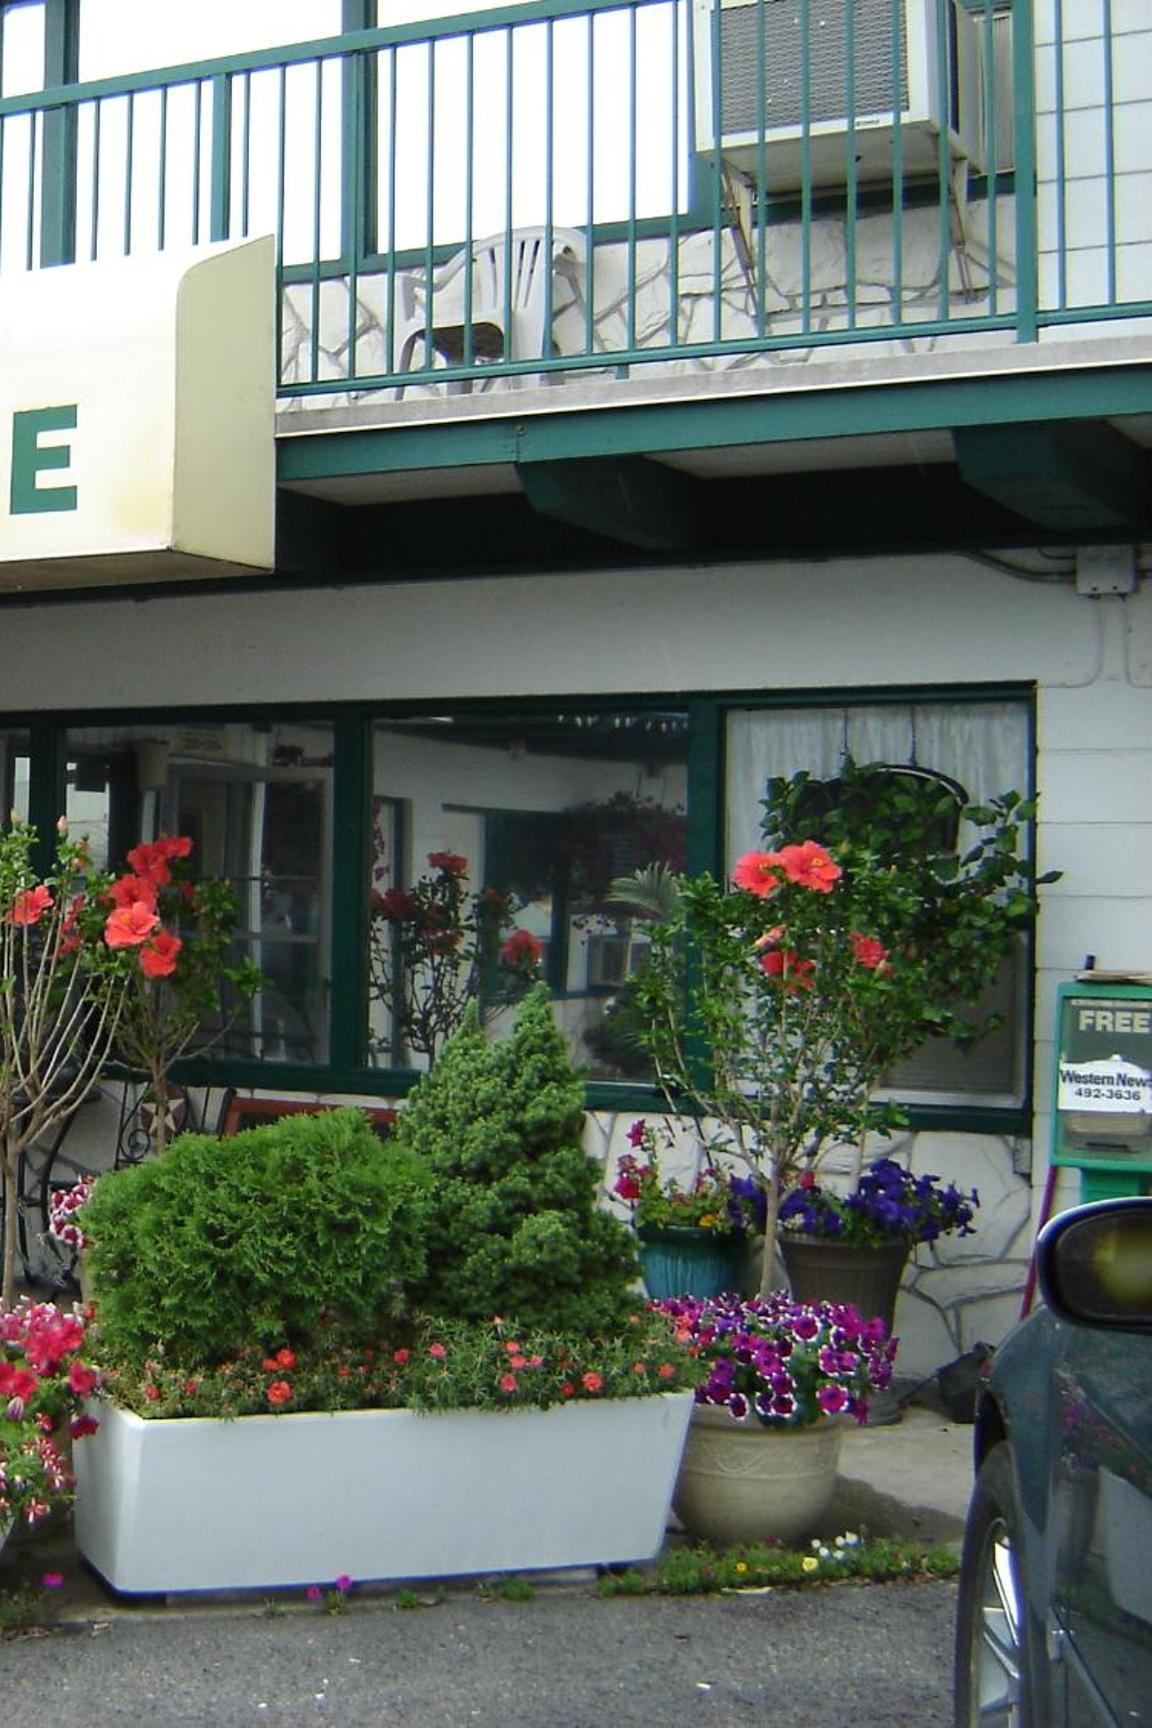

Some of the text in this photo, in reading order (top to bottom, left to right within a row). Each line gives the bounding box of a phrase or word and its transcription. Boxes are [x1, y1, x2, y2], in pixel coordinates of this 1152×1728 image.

[1078, 1010, 1151, 1034] FREE
[1059, 1069, 1114, 1086] Western
[1075, 1088, 1141, 1101] 492-3636
